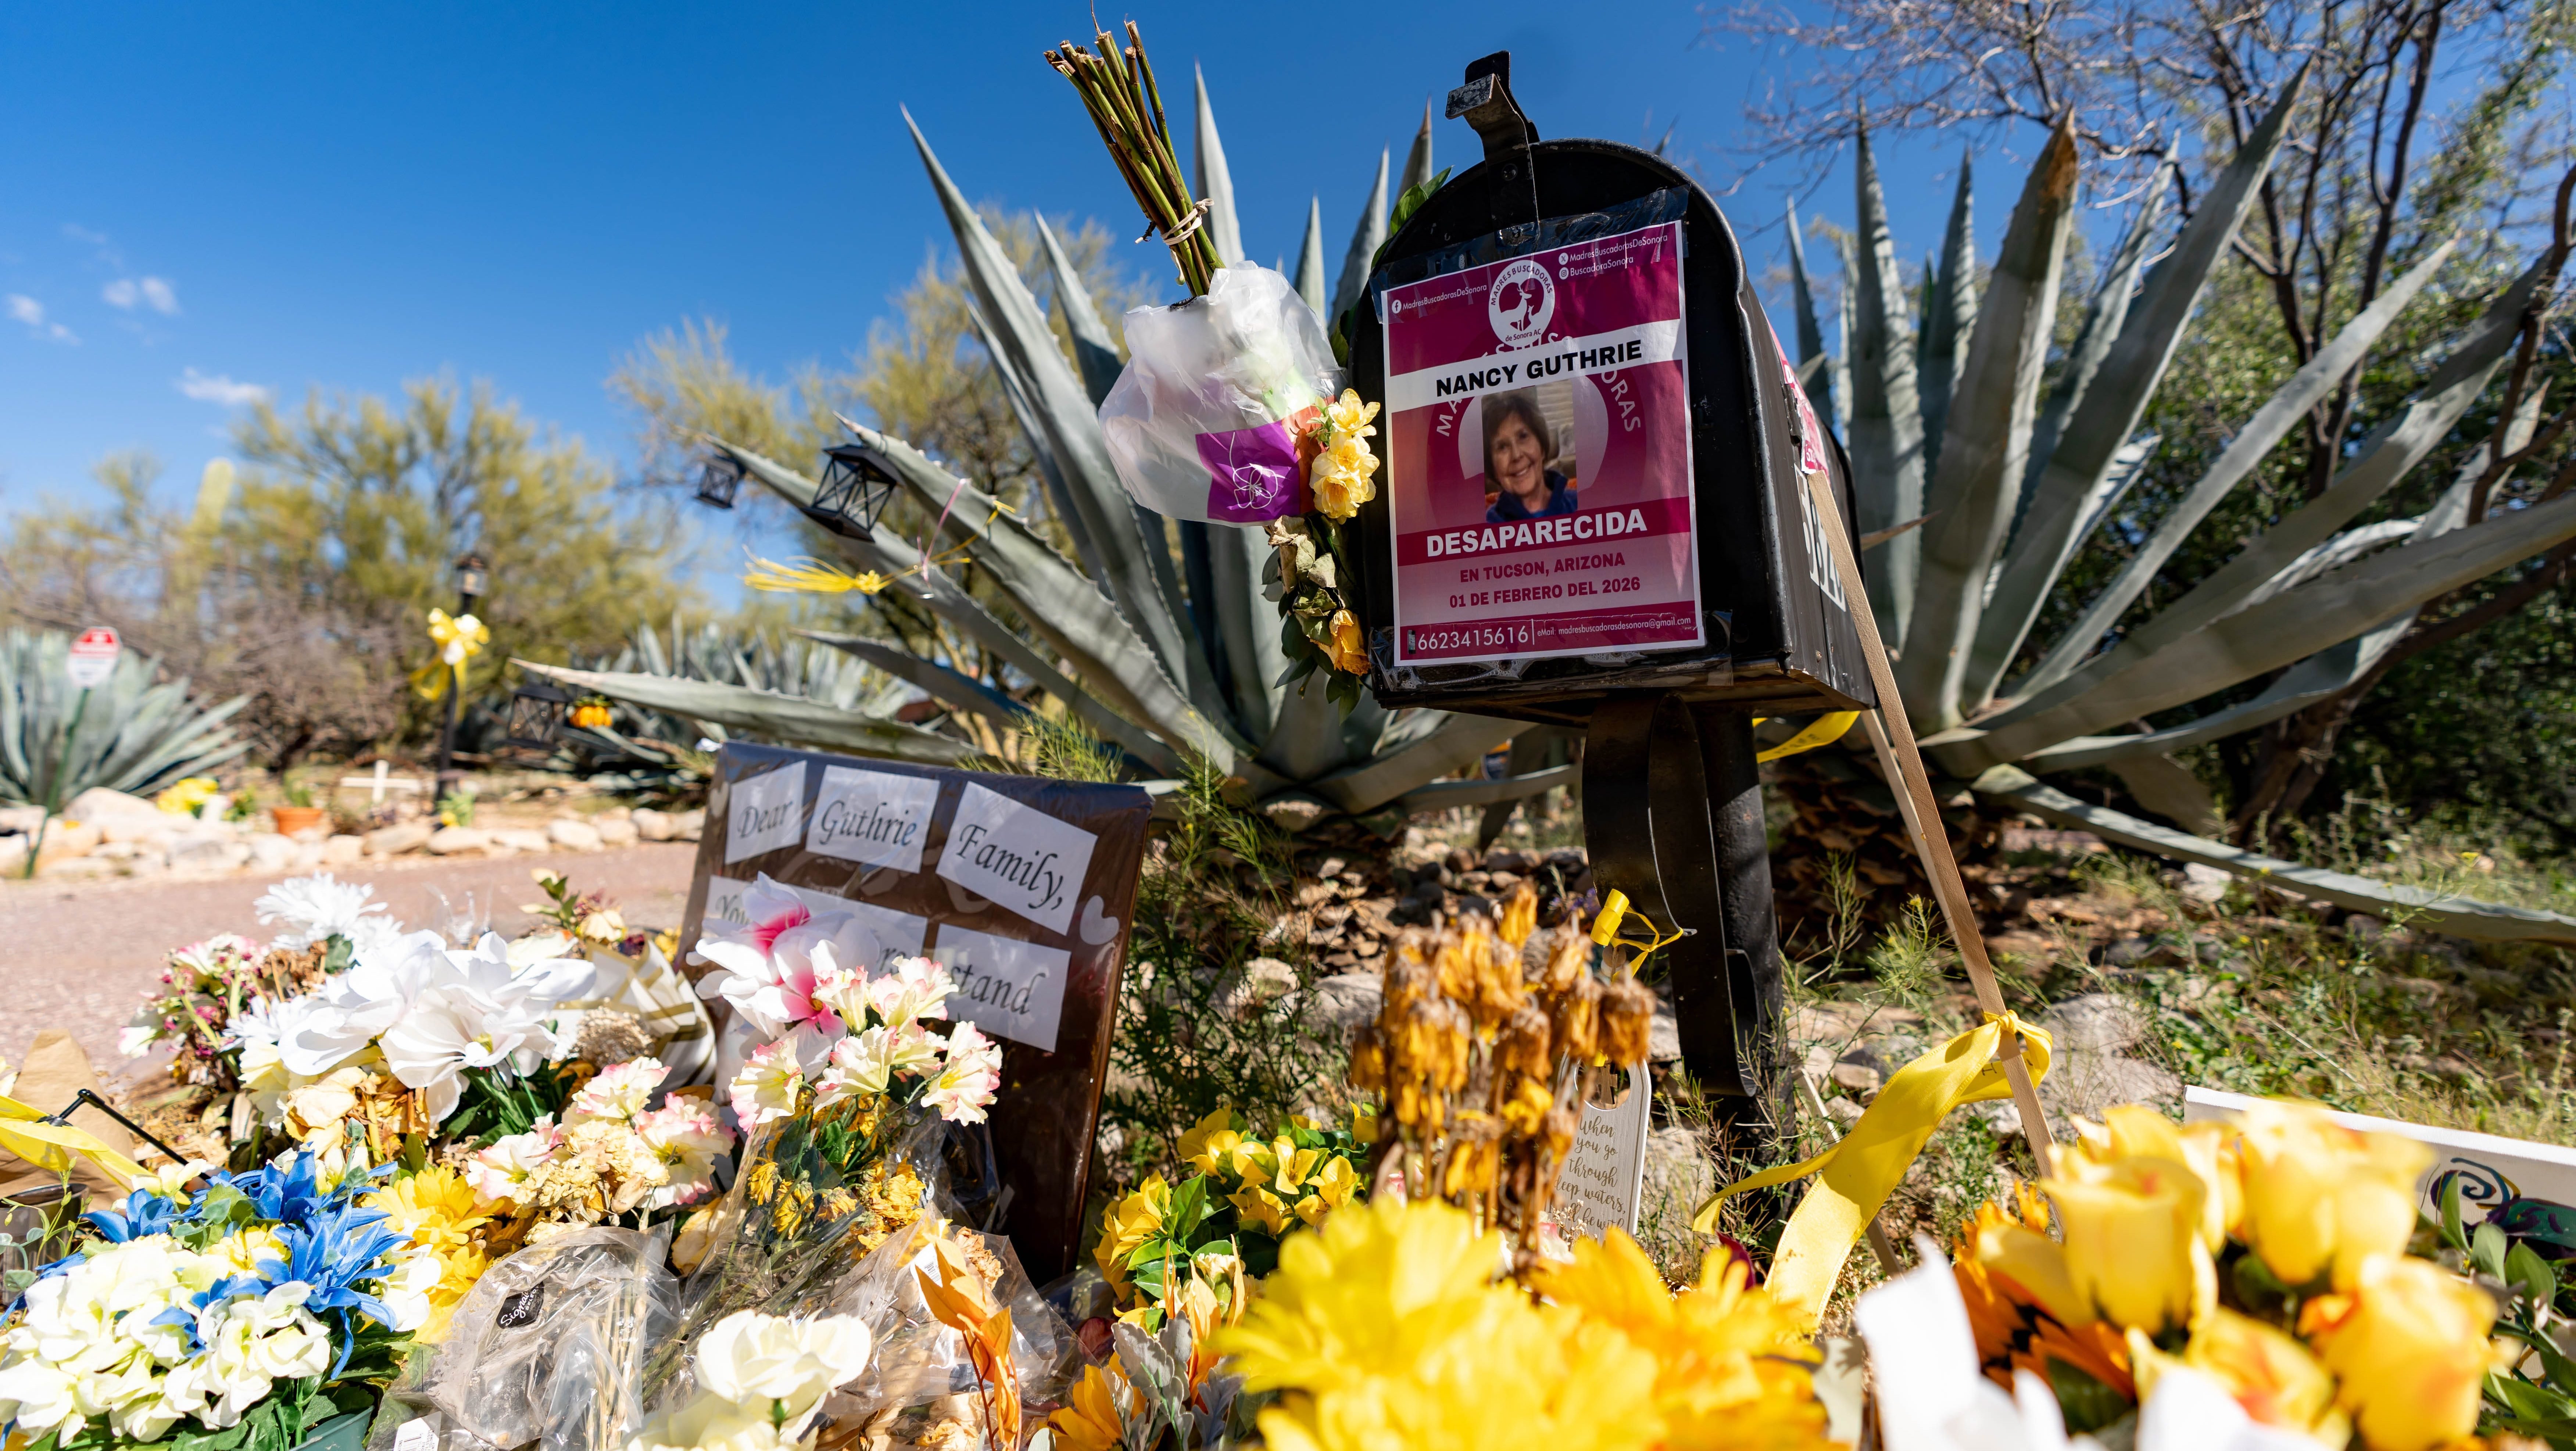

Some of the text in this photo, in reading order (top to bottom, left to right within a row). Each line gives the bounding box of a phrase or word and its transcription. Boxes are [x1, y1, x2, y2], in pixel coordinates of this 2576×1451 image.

[1570, 235, 1668, 262] MadresBuscadorasDeSonora
[1570, 256, 1634, 276] BuscadoraSonora
[1403, 285, 1487, 310] MadresBuscadorasDeSonora
[1491, 265, 1553, 305] MADRES BUSCADORAS
[1513, 331, 1532, 340] Sonora
[1436, 363, 1518, 397] NANCY
[1526, 340, 1642, 380] GUTHRIE
[1427, 508, 1647, 557] DESAPARECIDA
[1460, 552, 1625, 583] EN TUCSON, ARIZONA
[1450, 577, 1641, 608] 01 DE FEBRERO DEL 2026
[1418, 626, 1528, 650] 6623415616
[1559, 617, 1691, 635] madresbuscadorasdesonora@gmail.com
[737, 800, 1063, 910] Dear Guthrie Family,
[1579, 1114, 1614, 1137] When
[1575, 1137, 1618, 1160] you go
[1568, 1157, 1617, 1187] through
[1554, 1175, 1625, 1214] deep waters,
[1583, 1208, 1596, 1226] be
[525, 1287, 537, 1310] SELEC
